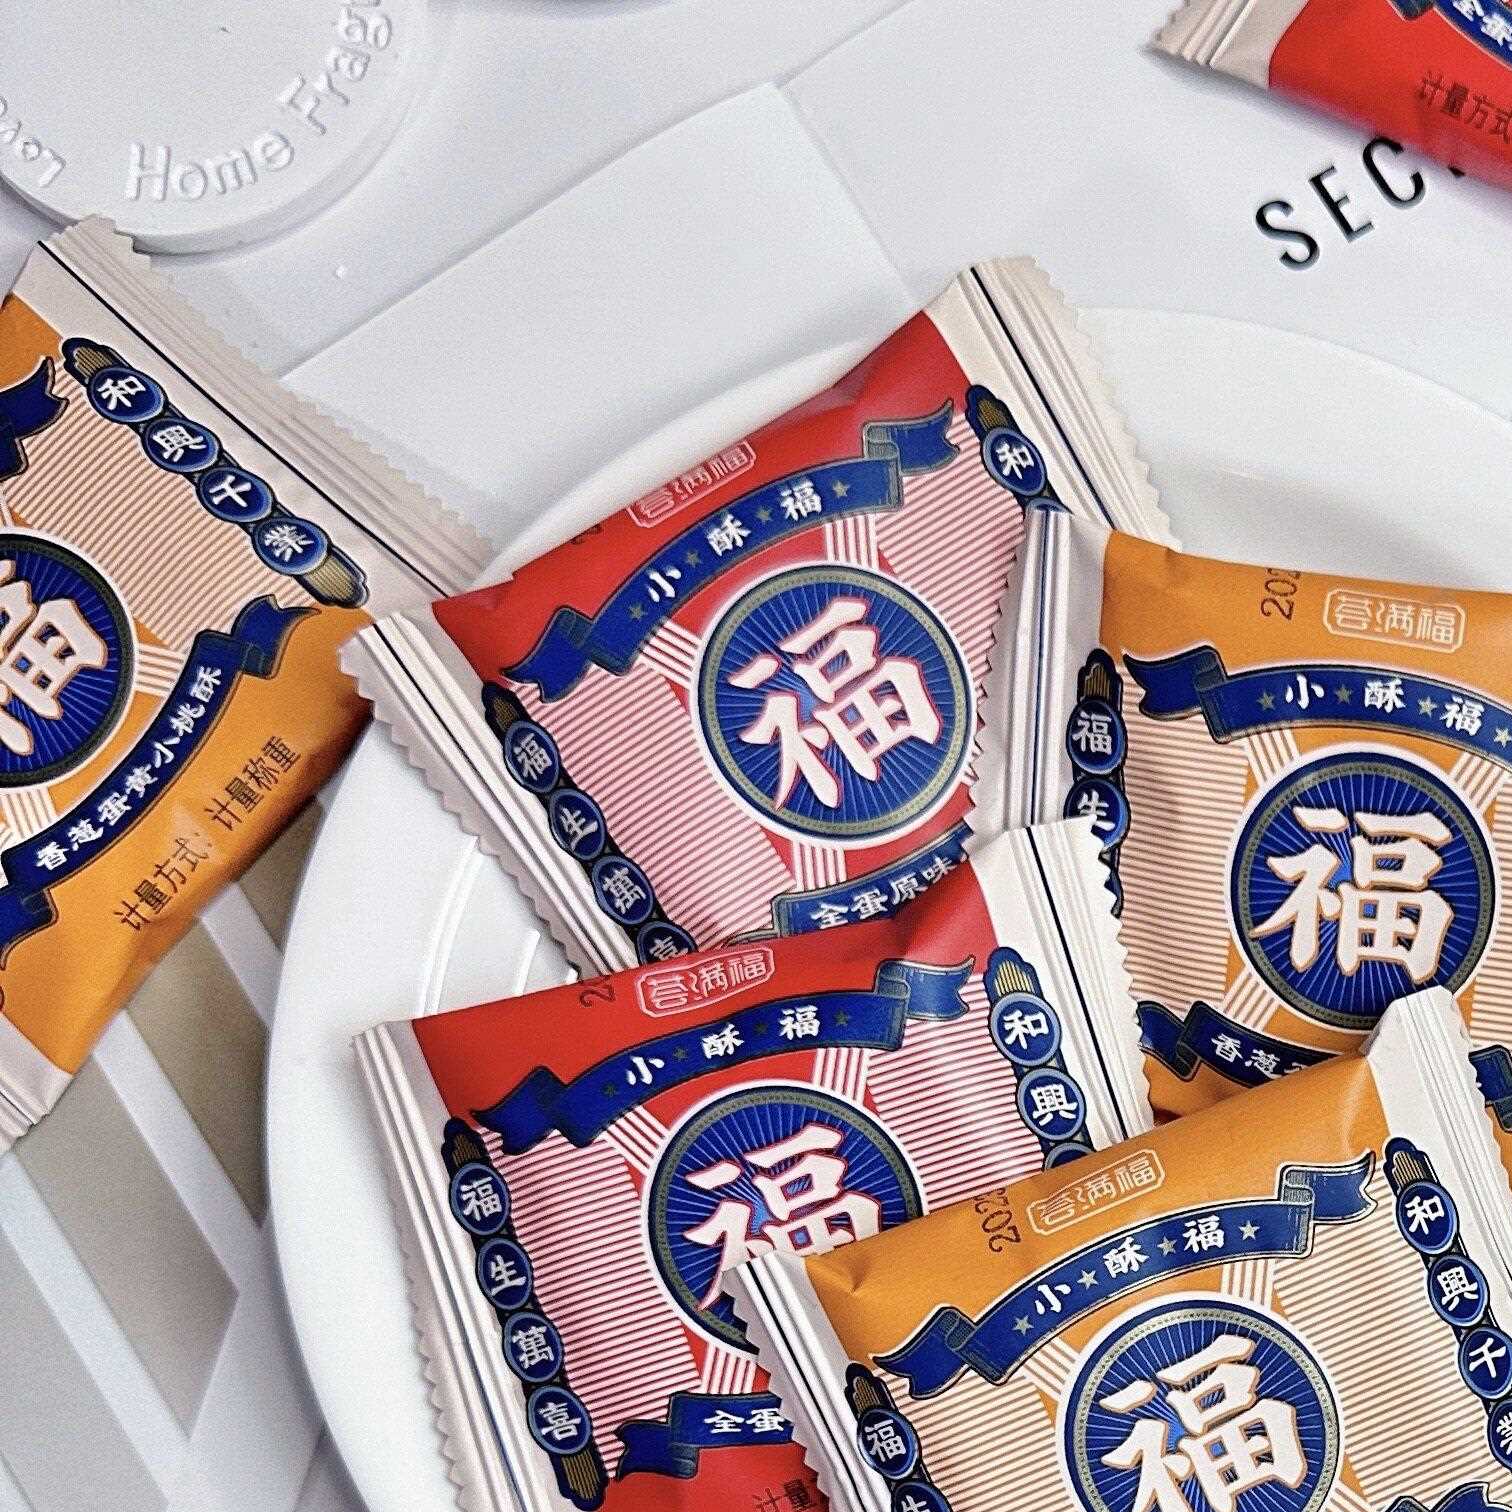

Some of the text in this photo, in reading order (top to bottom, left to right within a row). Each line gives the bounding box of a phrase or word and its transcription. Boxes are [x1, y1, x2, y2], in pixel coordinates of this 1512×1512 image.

[124, 130, 295, 202] Home
[1254, 134, 1468, 272] SEC
[729, 599, 939, 810] 福
[1284, 674, 1482, 734] 小酥福
[811, 853, 967, 930] 全蛋原味
[1254, 807, 1456, 982] 福
[626, 1006, 819, 1086] 小酥福
[1003, 1010, 1075, 1128] 和興
[686, 1125, 880, 1309] 福
[1032, 1214, 1224, 1315] 小酥福
[460, 1179, 578, 1442] 福生萬喜
